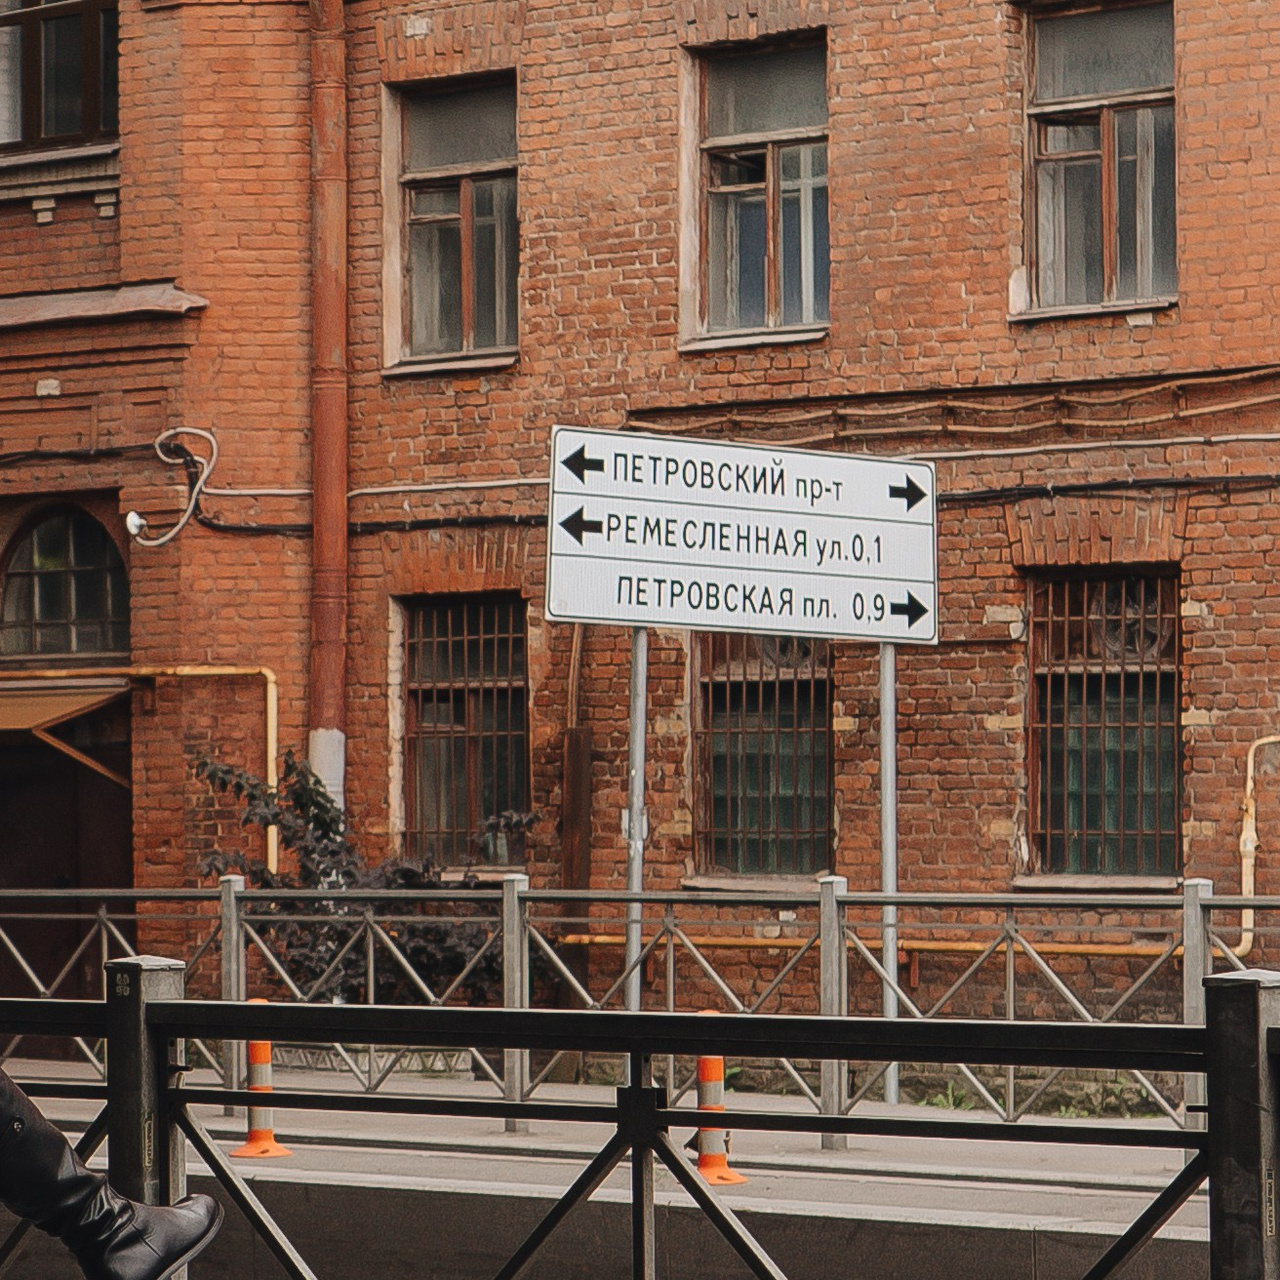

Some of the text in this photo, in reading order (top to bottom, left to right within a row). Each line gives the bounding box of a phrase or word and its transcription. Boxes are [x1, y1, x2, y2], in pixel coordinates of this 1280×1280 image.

[613, 452, 843, 507] ПЕТРОВСКИЙ пр-т
[606, 513, 807, 558] РЕМЕСЛЕННАЯ
[617, 576, 885, 624] ПЕТРОВСКАЯ пл. 0,9
